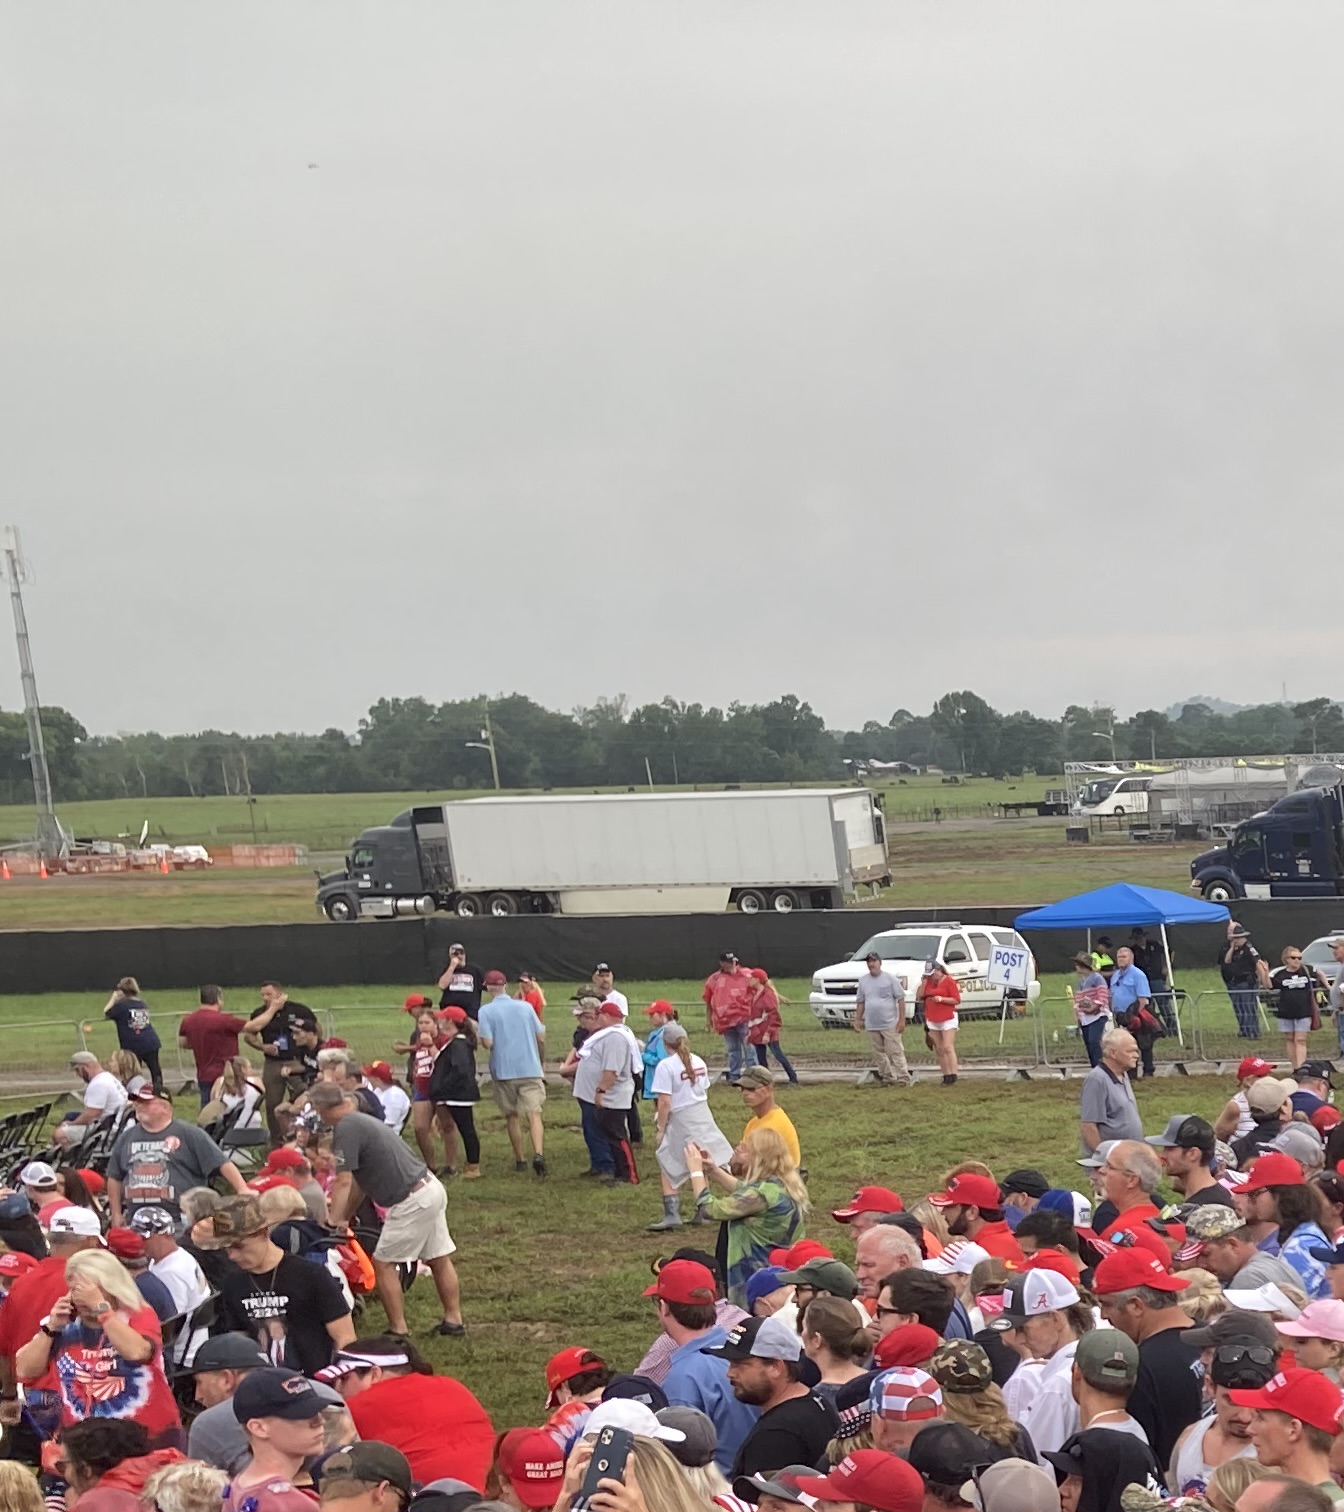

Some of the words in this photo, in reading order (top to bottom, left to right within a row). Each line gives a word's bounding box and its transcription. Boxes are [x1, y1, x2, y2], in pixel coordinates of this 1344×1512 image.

[995, 950, 1024, 968] POST
[1003, 969, 1011, 982] 4
[241, 1295, 290, 1311] TRUMP
